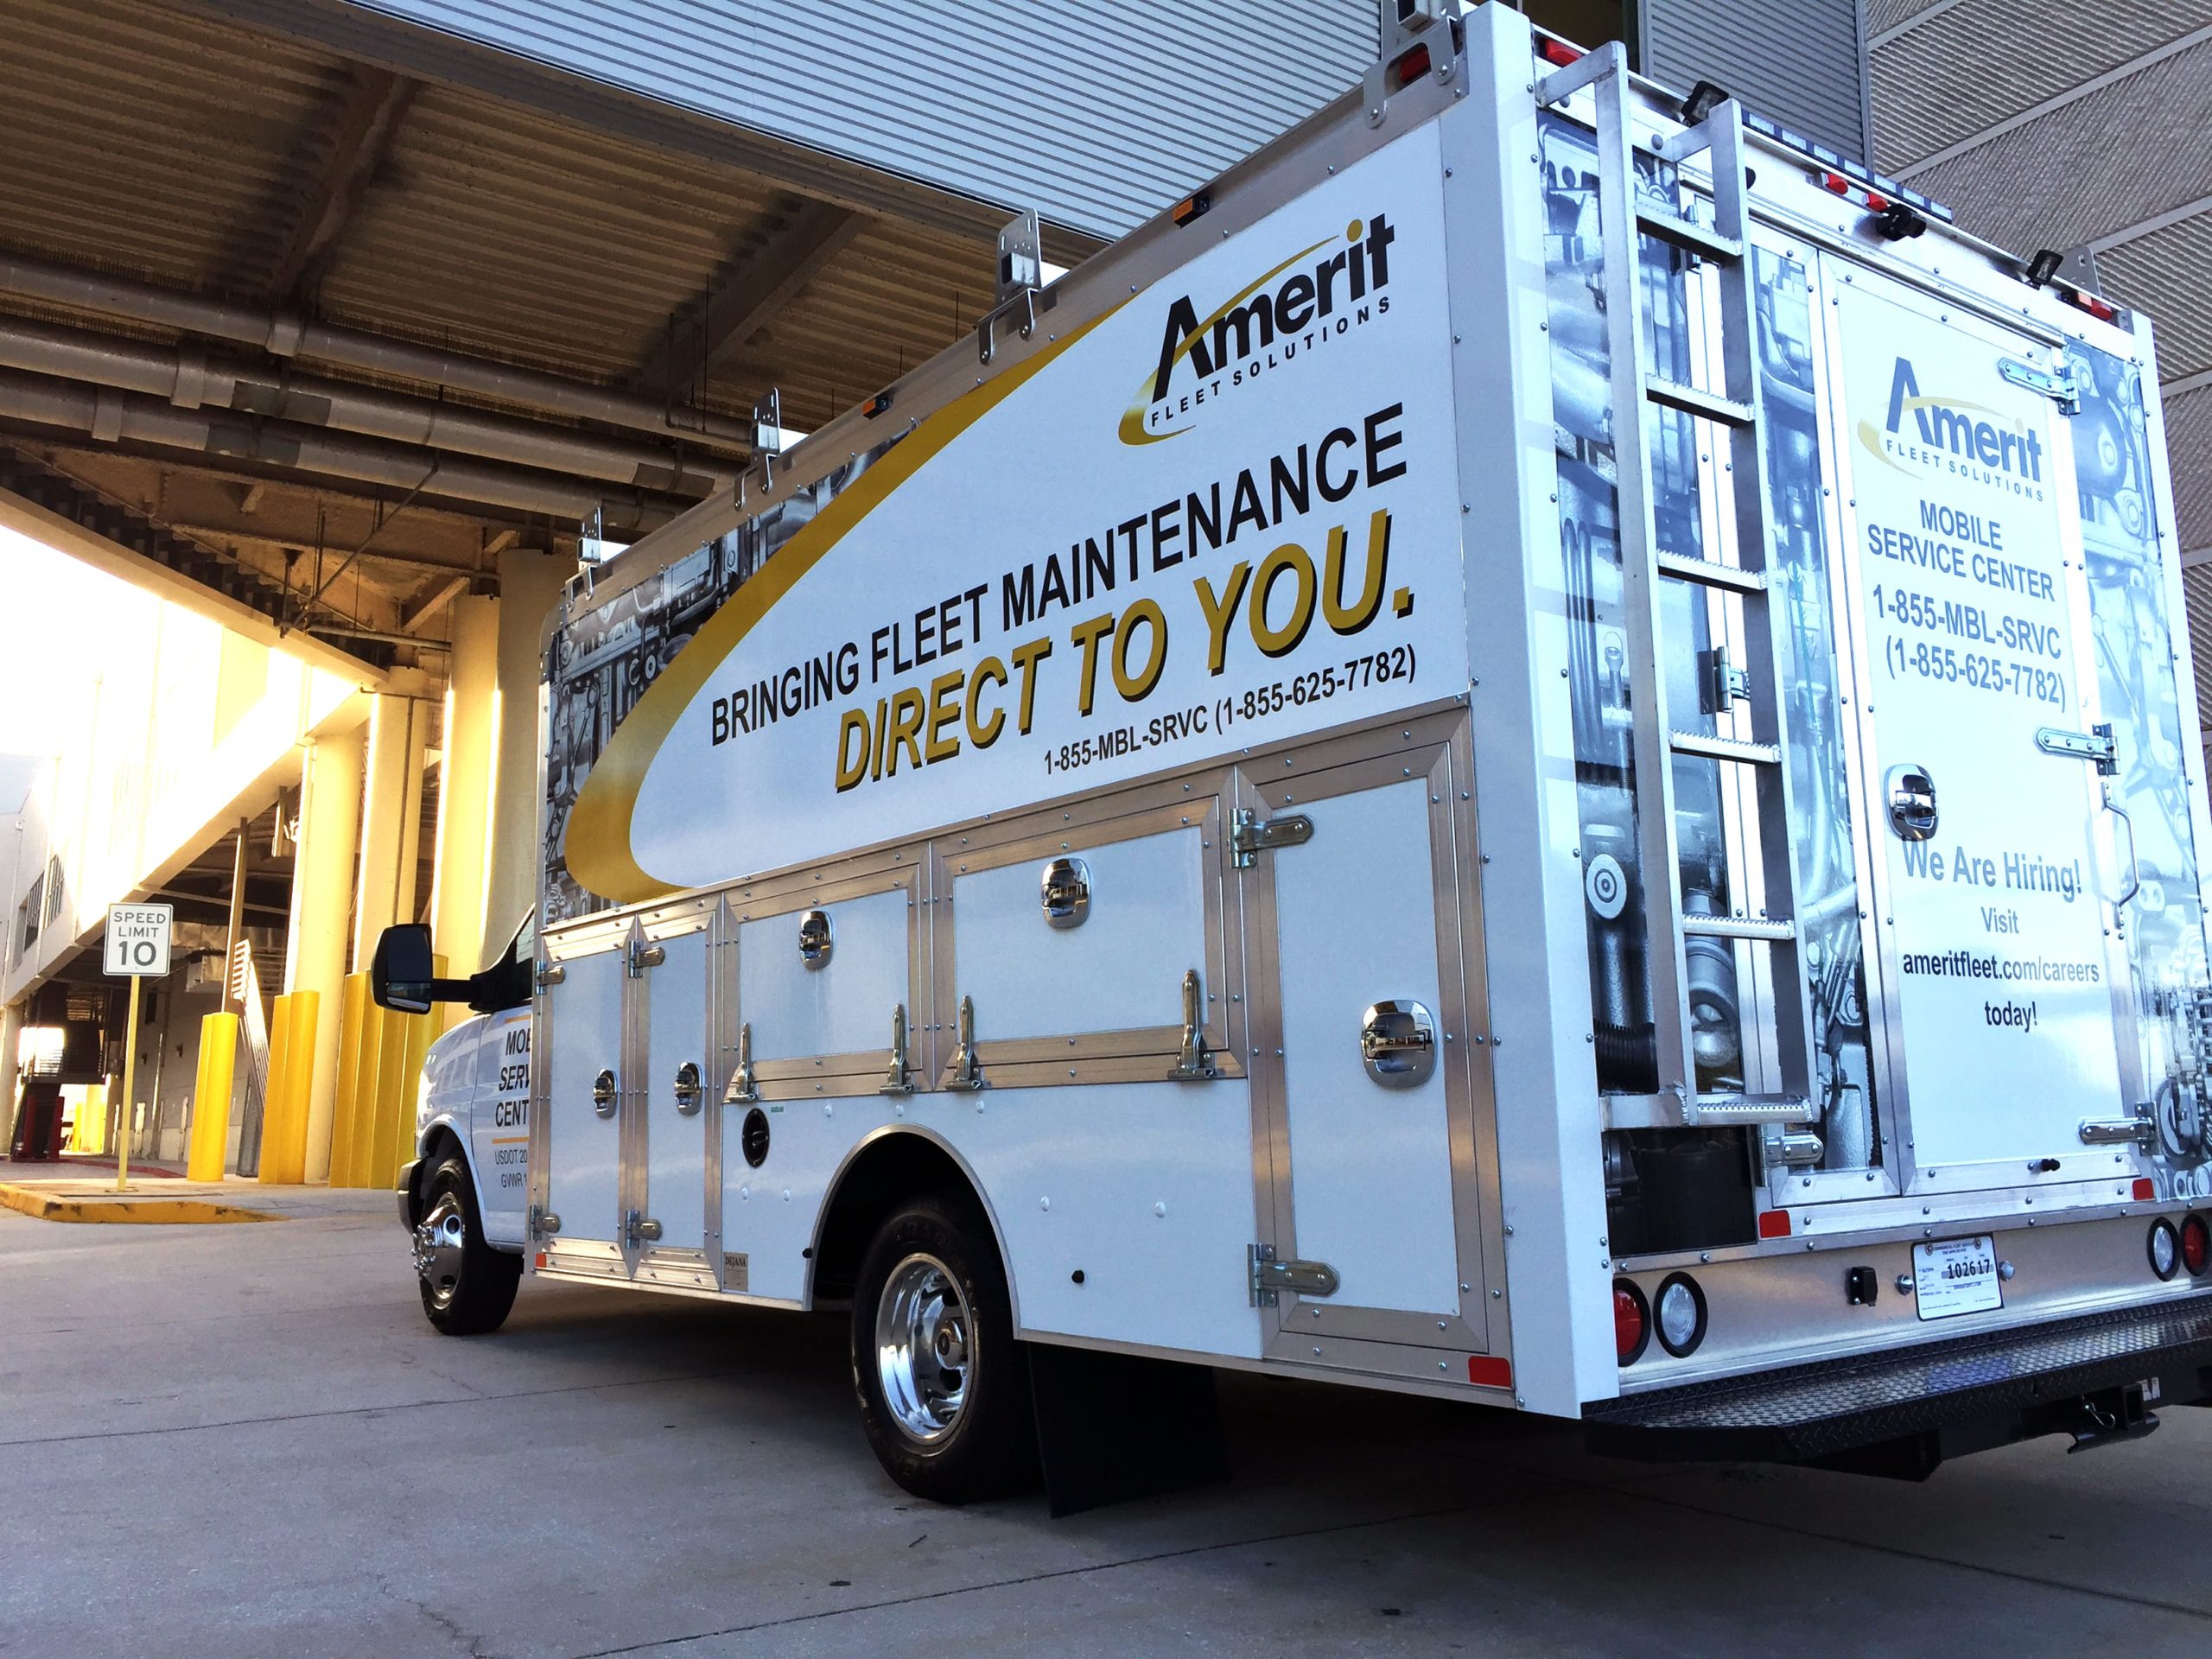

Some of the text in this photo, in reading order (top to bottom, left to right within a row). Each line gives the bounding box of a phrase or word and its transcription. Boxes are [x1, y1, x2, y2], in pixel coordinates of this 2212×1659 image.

[1152, 213, 1395, 404] Amerit
[1152, 296, 1389, 427] FLEET SOLUTIONS
[1886, 357, 2042, 482] Amerit
[1886, 440, 2044, 502] FLEET SOLUTIONS
[1920, 499, 2003, 551] MOBILE
[712, 402, 1408, 747] BRINGING FLEET MAINTENANCE
[1868, 524, 2055, 601] SERVICE CENTER
[1873, 584, 2062, 659] 1-855-MBL-SRVC
[835, 508, 1414, 794] DIRECT TO YOU.
[1886, 635, 2066, 714] (1-855-625-7782)
[1044, 643, 1415, 775] 1-855-MBL-SRVC (1-855-625-7782)
[1903, 841, 2082, 903] We Are Hiring!
[113, 912, 167, 924] SPEED
[118, 926, 159, 938] LIMIT
[1980, 906, 2019, 934] Visit
[118, 941, 156, 966] 10
[1903, 950, 2100, 982] ameritfleet.com/careers
[1984, 1001, 2037, 1033] today!
[495, 1100, 530, 1127] CENT
[495, 1149, 518, 1165] USDOT
[501, 1173, 523, 1188] GVWR
[1948, 1259, 1990, 1280] 102617
